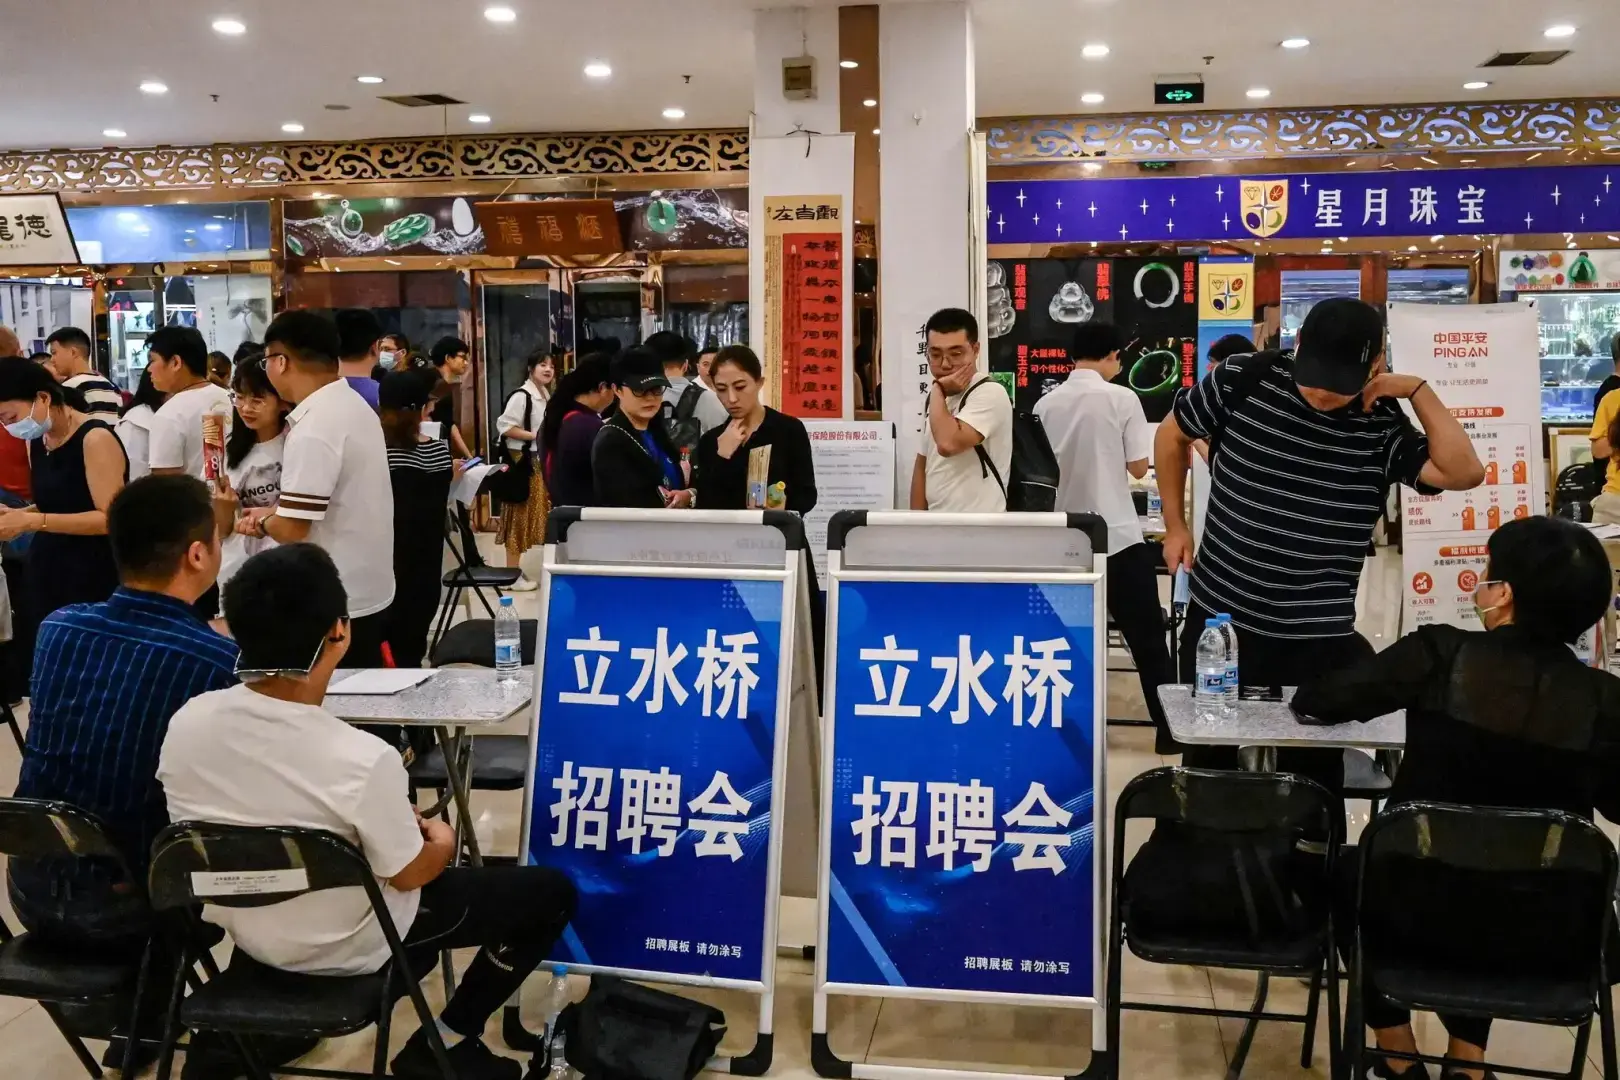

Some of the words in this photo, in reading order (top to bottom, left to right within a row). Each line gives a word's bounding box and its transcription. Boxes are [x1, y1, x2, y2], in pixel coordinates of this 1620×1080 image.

[1315, 185, 1485, 227] 星月珠宝
[1434, 332, 1488, 345] 中国平安
[559, 627, 760, 718] 立水桥
[855, 635, 1074, 729] 立水桥
[549, 760, 752, 862] 招聘会
[851, 776, 1073, 875] 招聘会
[645, 937, 690, 953] 招聘展板
[696, 942, 742, 958] 请勿涂写
[964, 956, 1013, 971] 招聘展板
[1020, 959, 1070, 975] 请勿涂写
